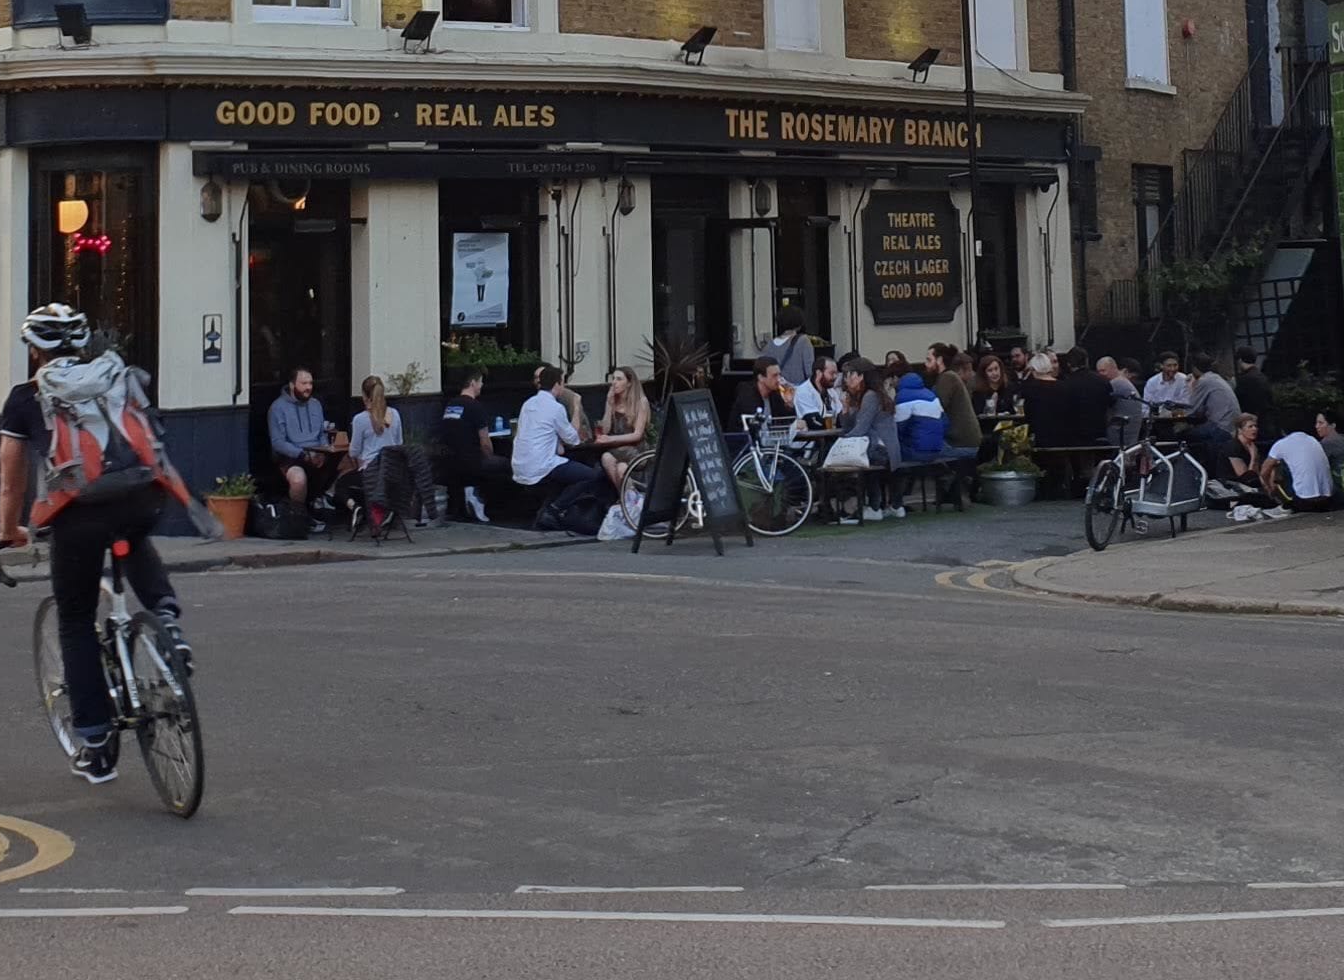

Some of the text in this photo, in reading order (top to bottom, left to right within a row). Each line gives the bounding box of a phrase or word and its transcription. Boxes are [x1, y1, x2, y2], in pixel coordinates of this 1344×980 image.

[216, 101, 556, 127] GOOD FOOD REAL ALES
[725, 108, 769, 139] THE
[781, 111, 895, 144] ROSEMARY
[232, 163, 258, 174] PUB
[275, 163, 323, 174] DINING
[326, 163, 371, 174] ROOMS
[887, 212, 936, 228] THEATRE
[882, 234, 941, 251] REAL ALES
[874, 259, 949, 276] CZECH LAGER
[881, 282, 944, 299] GOOD FOOD
